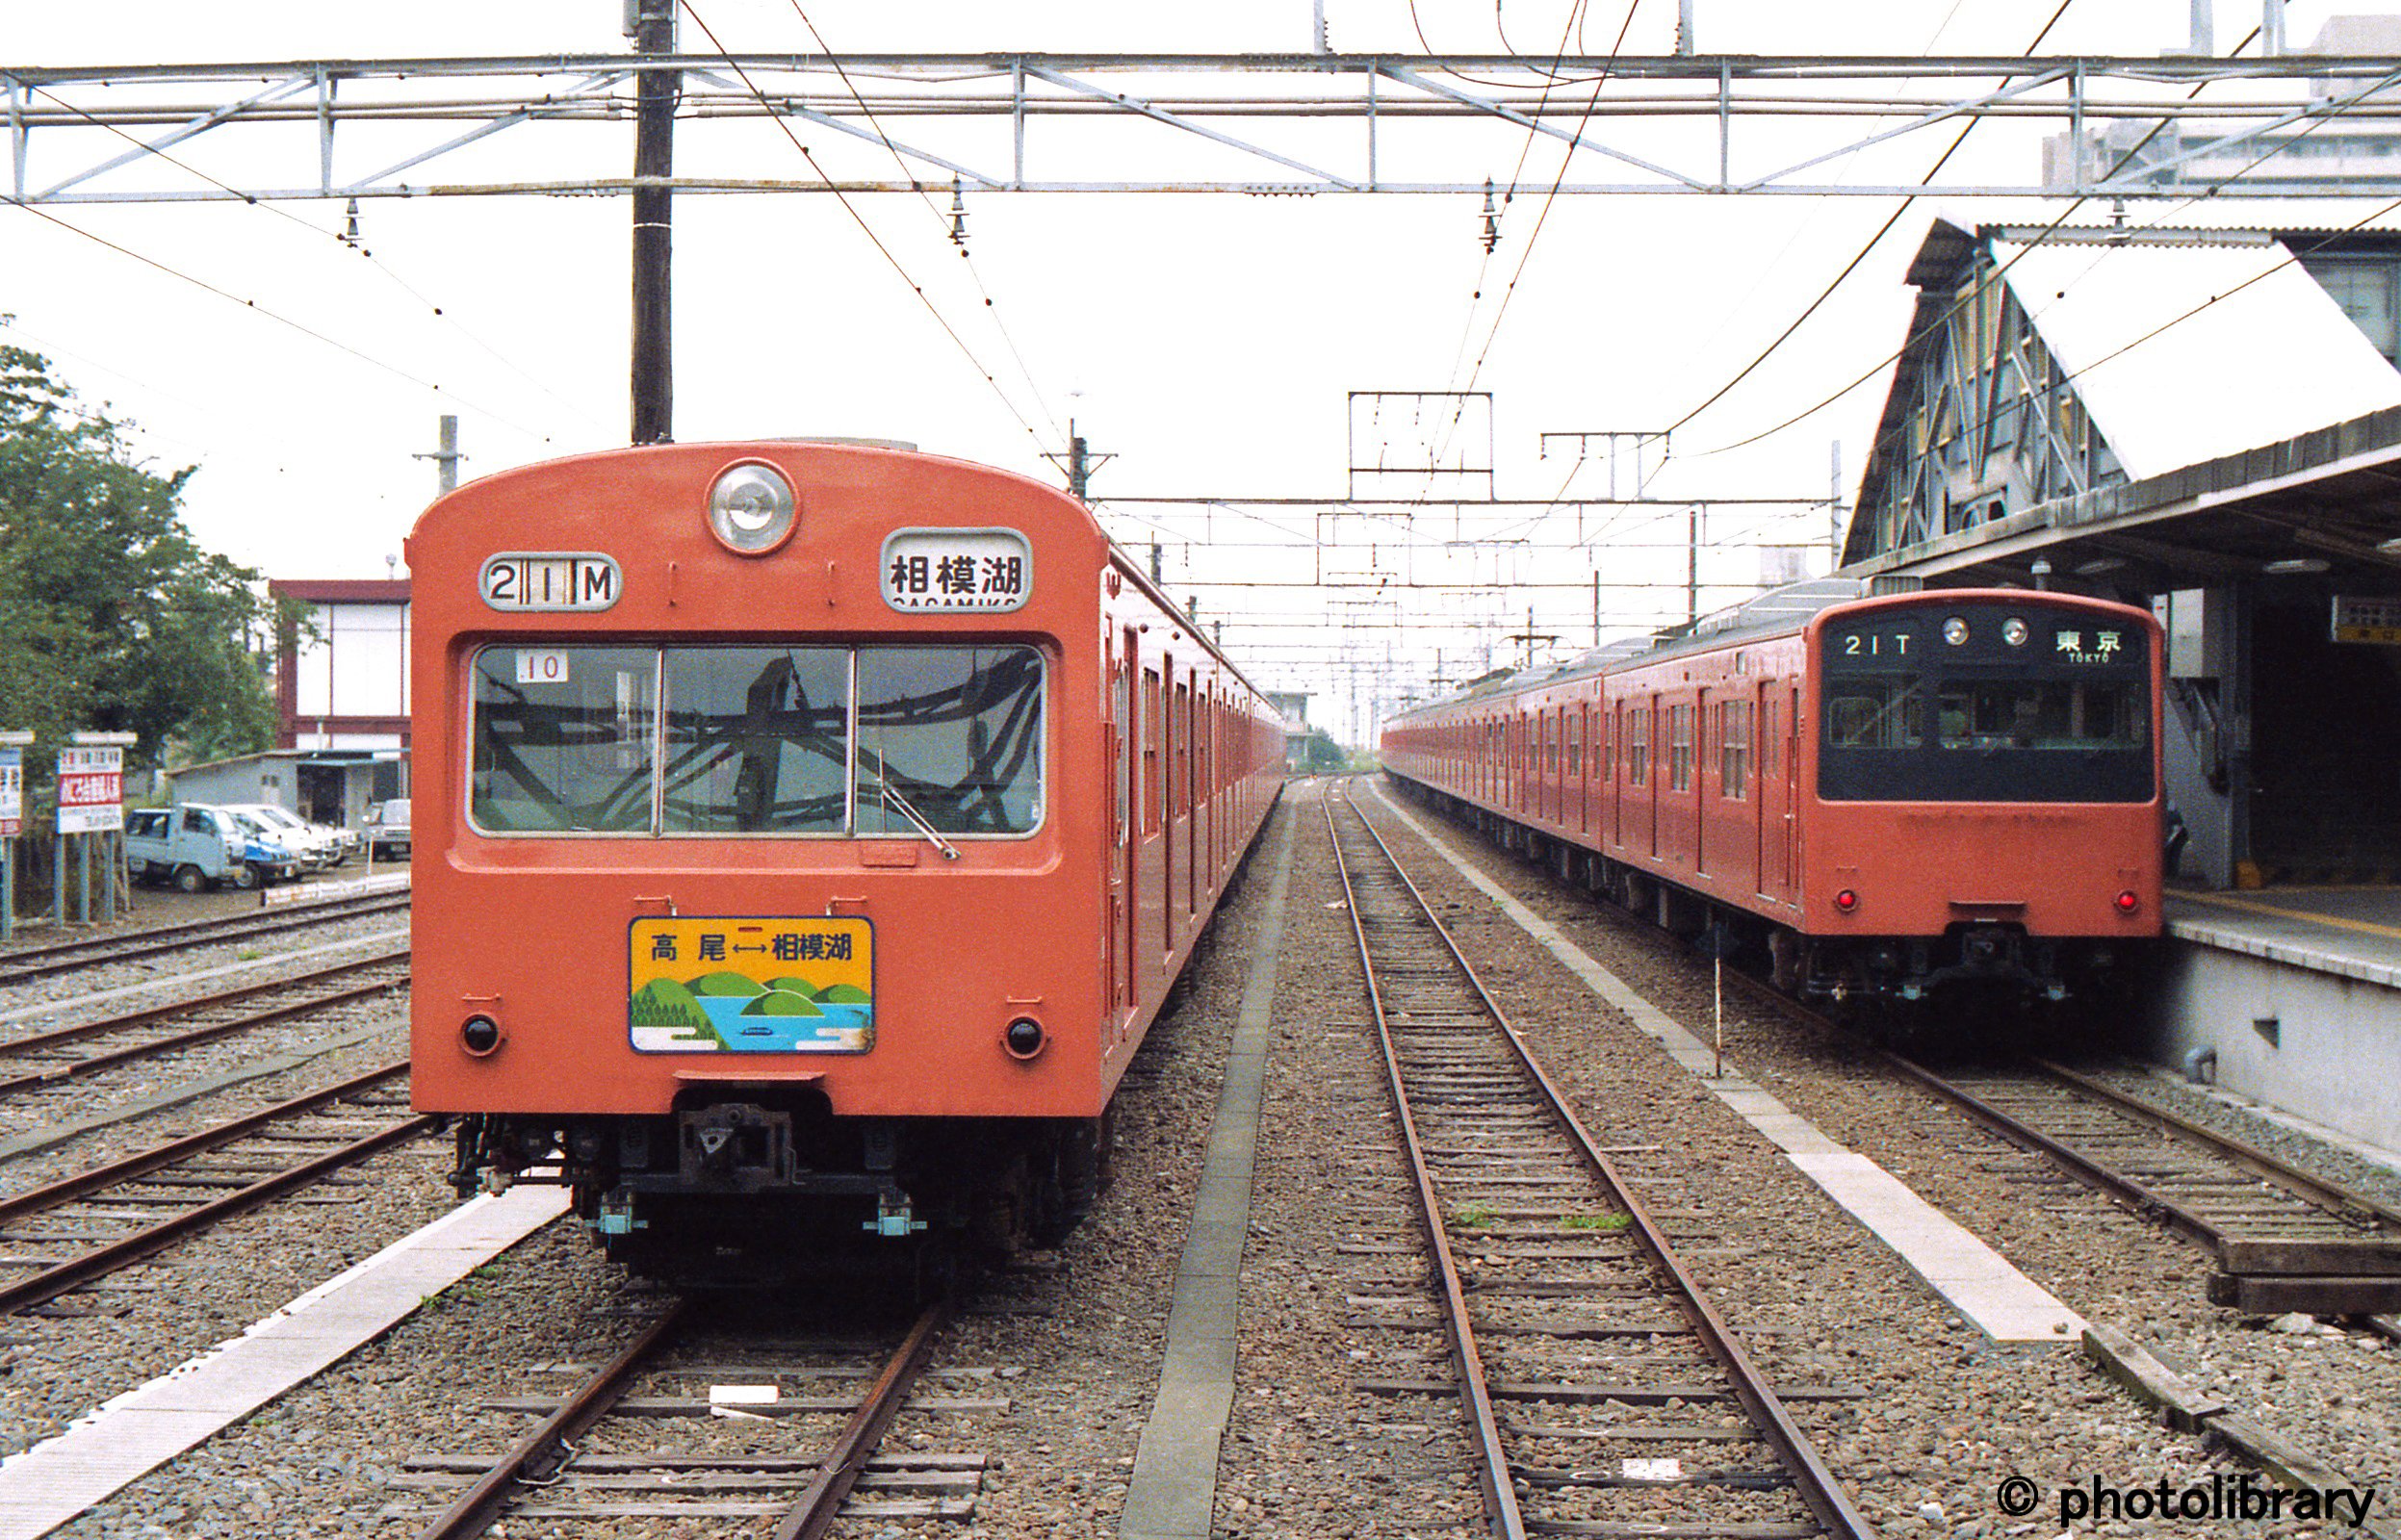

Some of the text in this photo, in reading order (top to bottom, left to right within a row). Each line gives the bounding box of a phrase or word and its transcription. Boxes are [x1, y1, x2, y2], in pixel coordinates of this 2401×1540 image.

[891, 555, 1021, 595] 相模湖
[2055, 630, 2122, 652] 東京
[529, 655, 557, 680] 10
[771, 934, 852, 961] 相模湖
